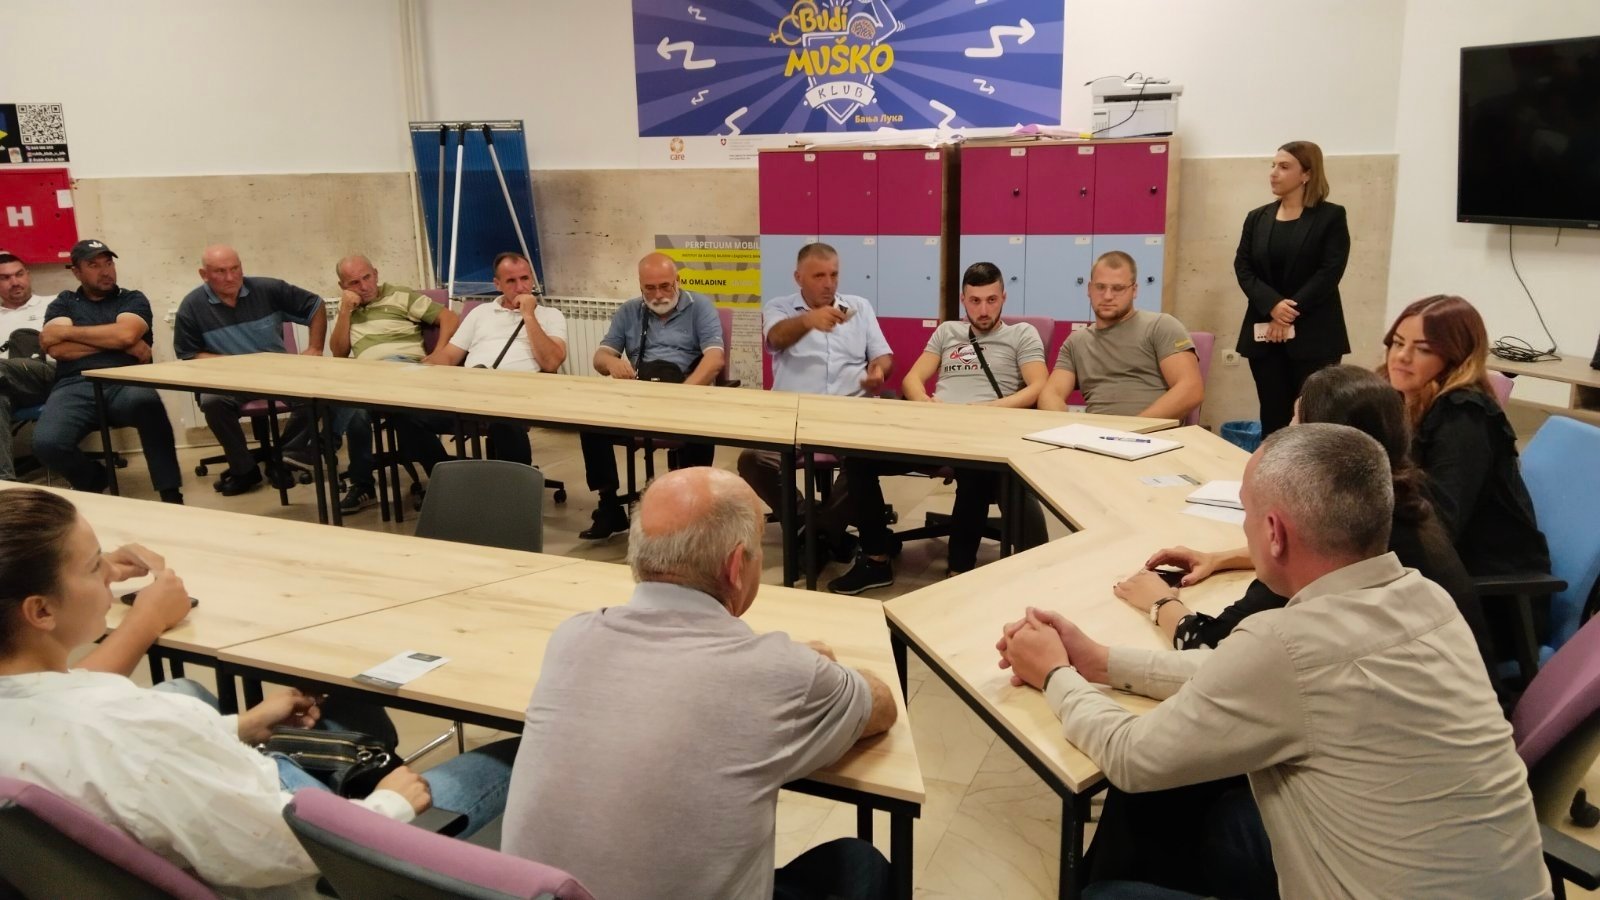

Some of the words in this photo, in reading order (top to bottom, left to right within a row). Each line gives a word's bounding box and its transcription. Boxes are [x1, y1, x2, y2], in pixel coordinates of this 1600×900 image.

[799, 6, 848, 33] Budi
[784, 36, 895, 77] MUŠKO
[817, 84, 864, 99] KLUB
[854, 115, 878, 123] Бања
[880, 114, 904, 125] Лука
[669, 153, 686, 161] care
[6, 205, 34, 227] H
[685, 241, 732, 249] PERPETUUM
